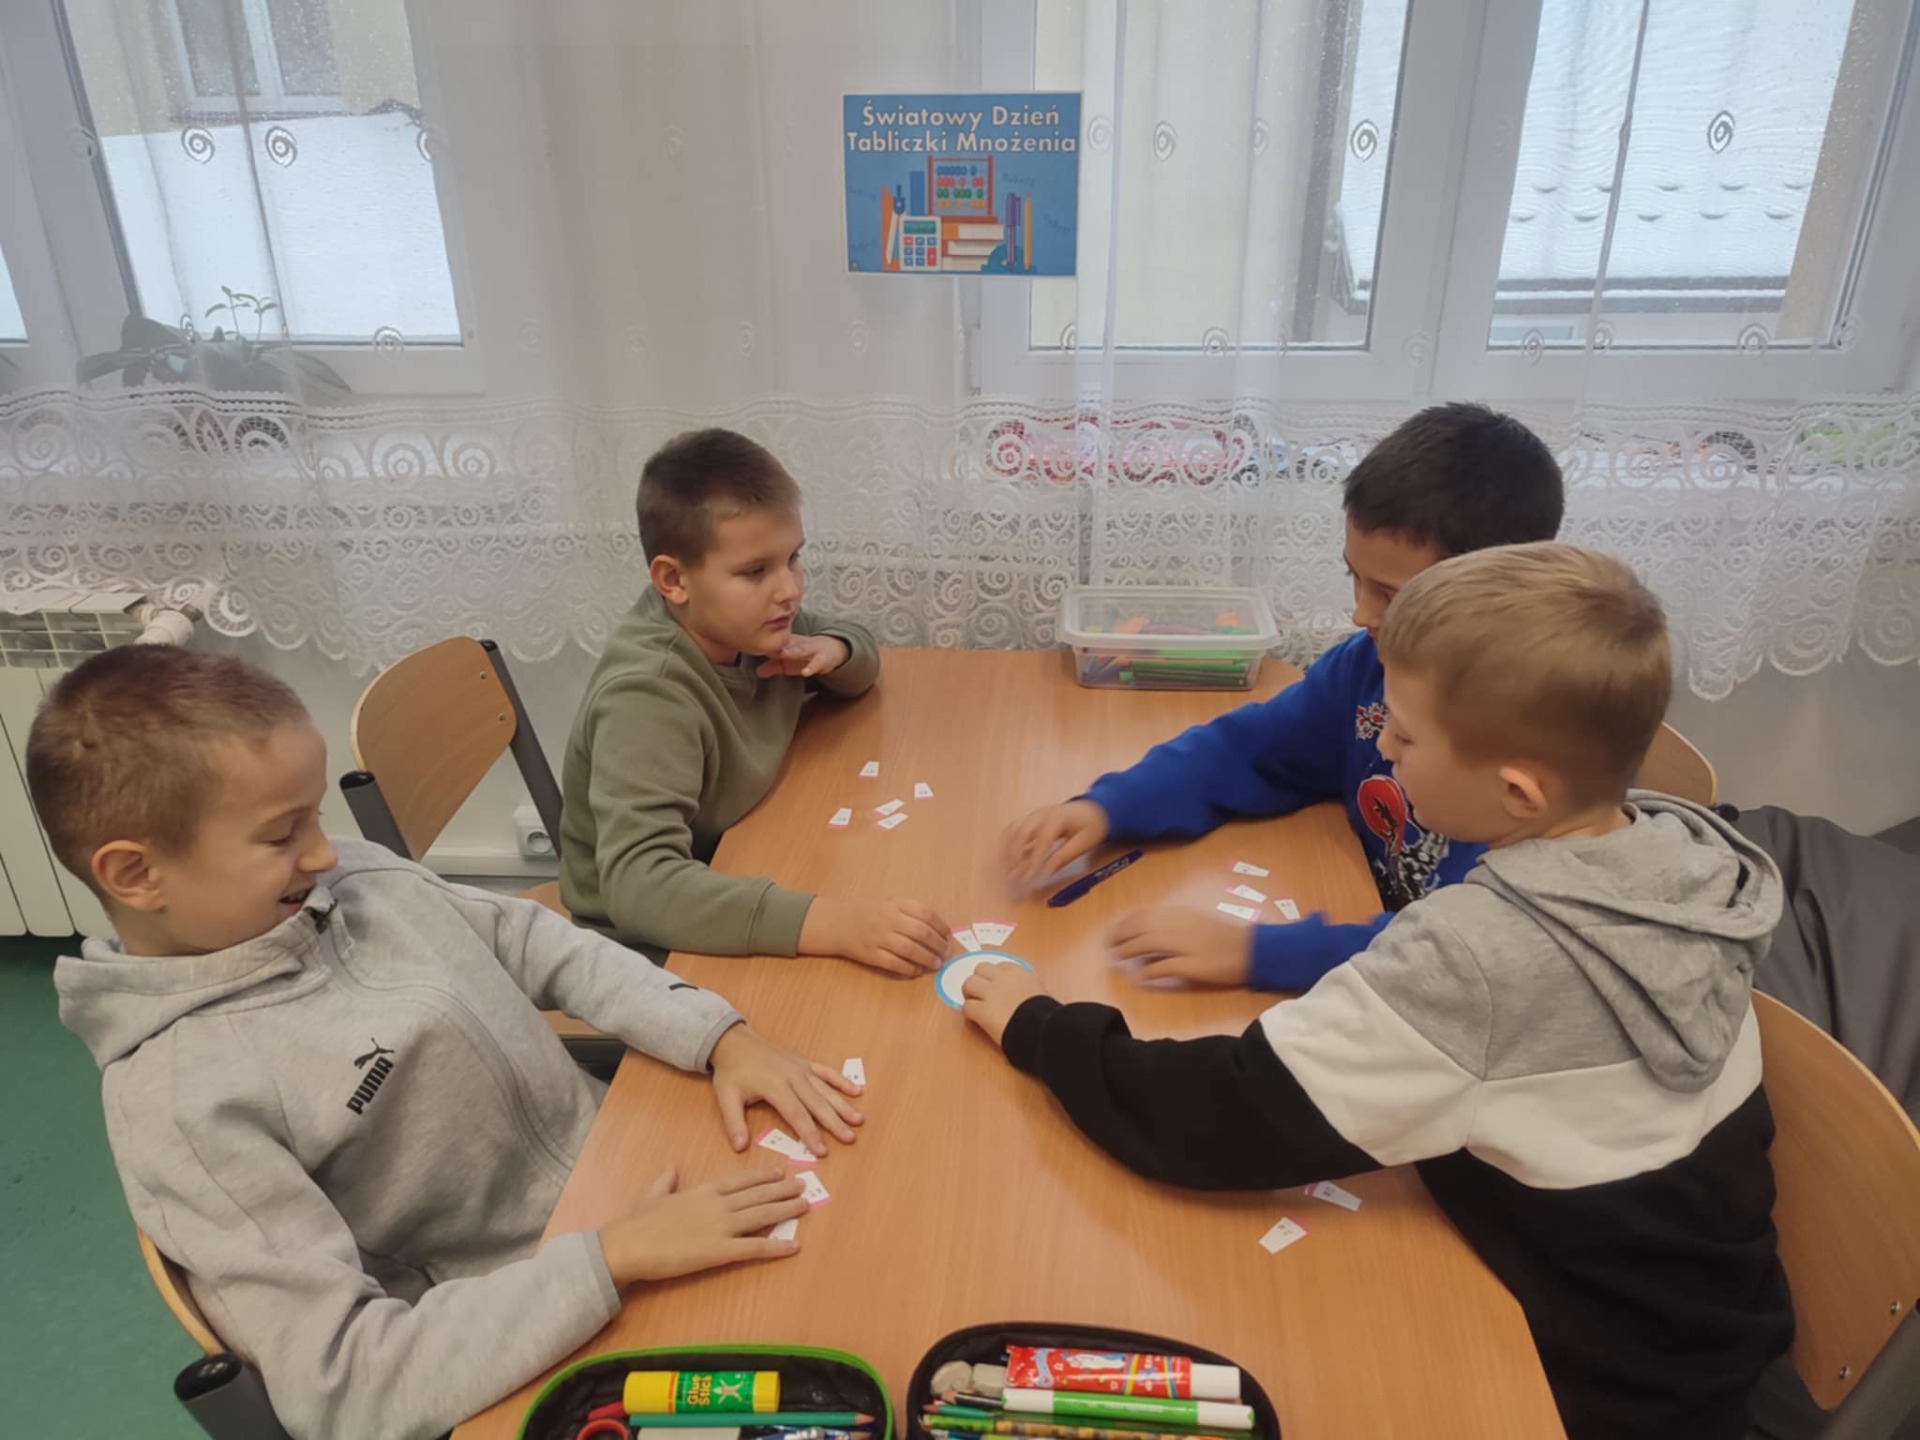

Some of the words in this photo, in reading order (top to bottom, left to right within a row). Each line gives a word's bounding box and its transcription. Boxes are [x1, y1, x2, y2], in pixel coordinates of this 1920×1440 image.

[863, 100, 983, 130] Światowy
[992, 104, 1060, 126] Dzień
[847, 130, 947, 151] Tabliczki
[956, 131, 1076, 152] Mnożenia
[345, 1056, 394, 1115] PUMA
[687, 1375, 700, 1405] Glue
